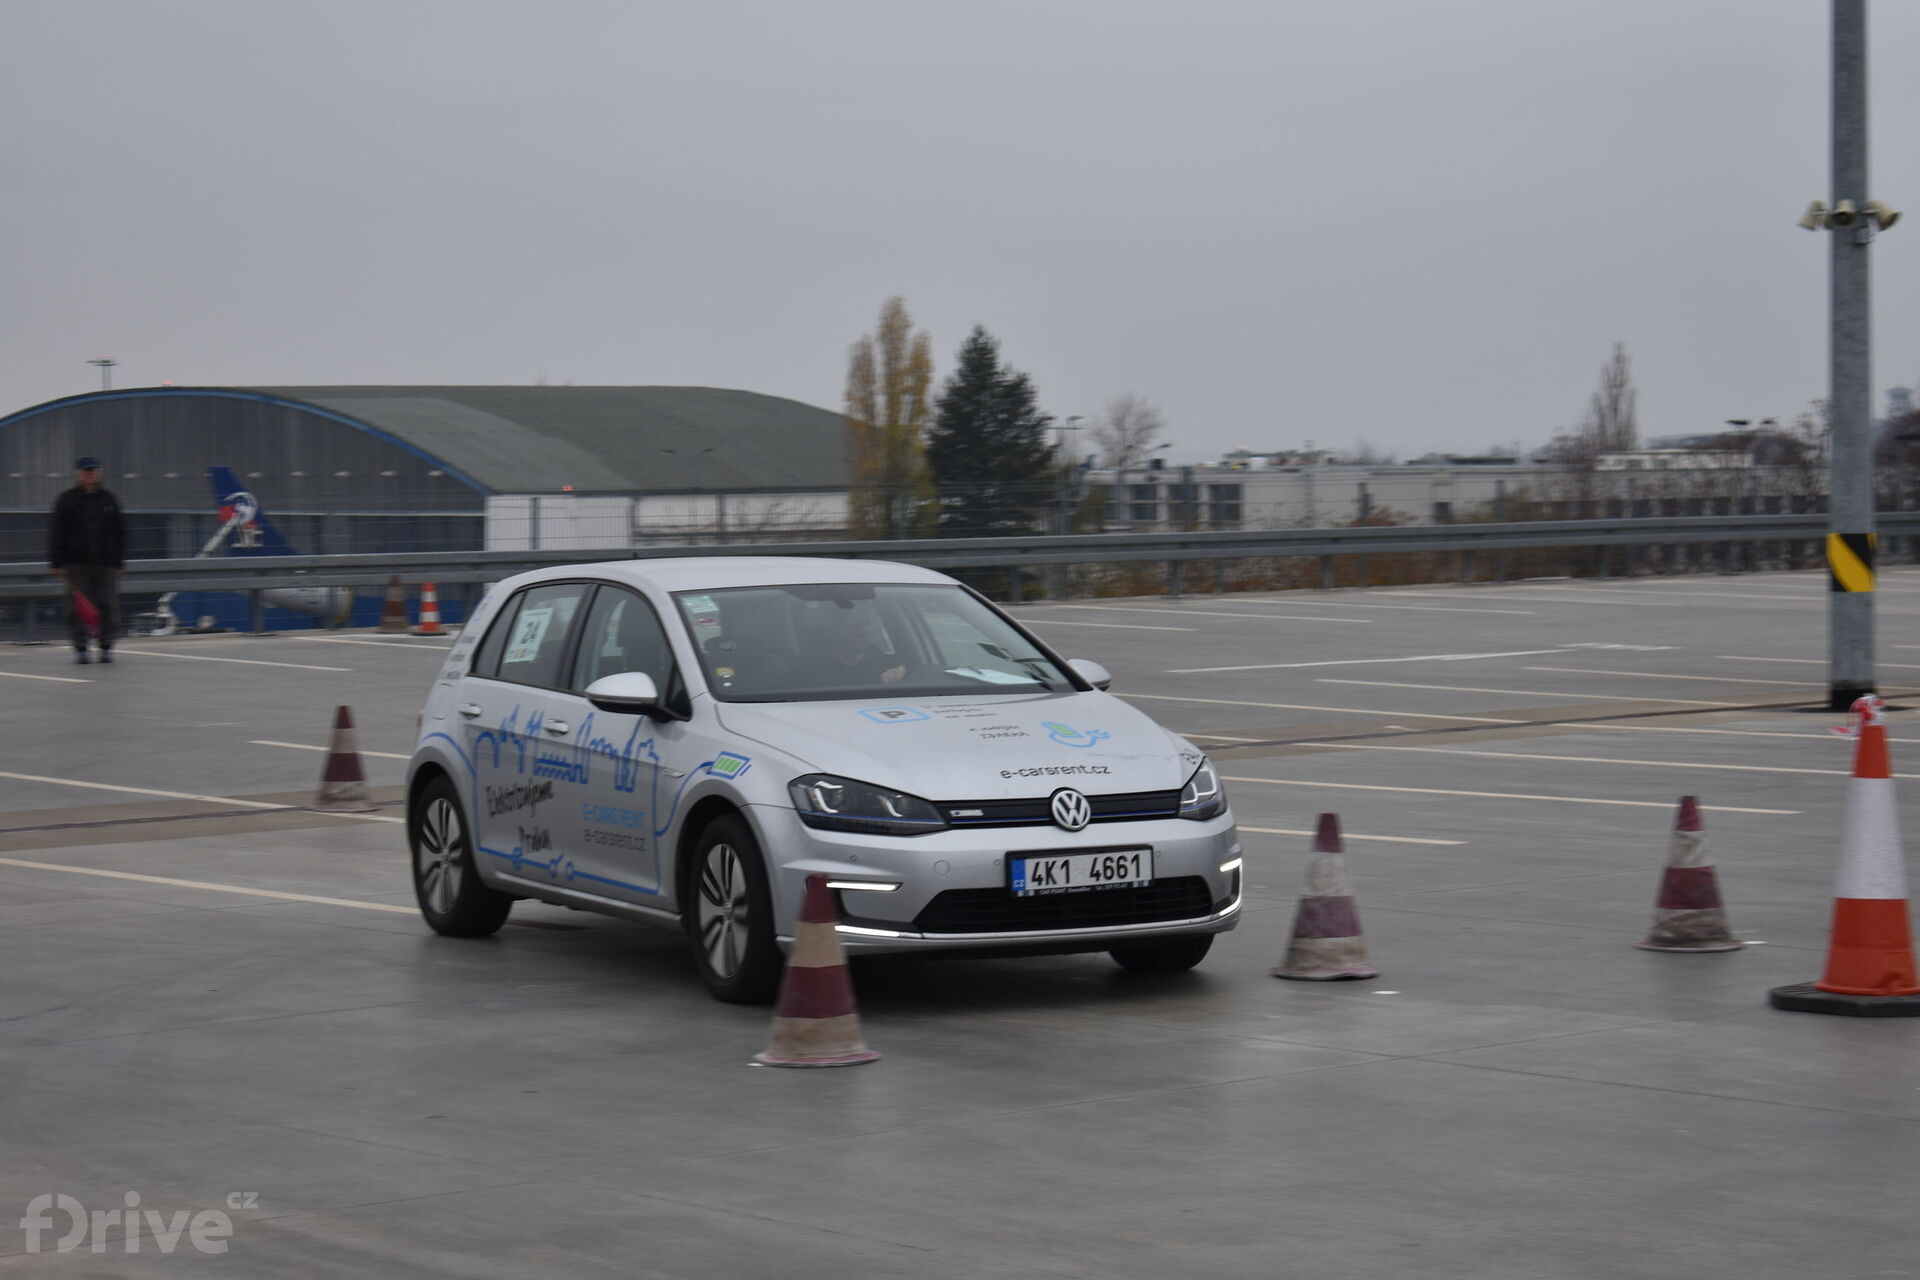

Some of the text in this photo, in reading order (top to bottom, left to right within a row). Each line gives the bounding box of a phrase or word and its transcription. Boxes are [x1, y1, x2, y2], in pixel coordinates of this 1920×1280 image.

[880, 710, 907, 719] P
[1000, 764, 1112, 779] e-carsrent.cz
[1031, 854, 1140, 886] 4K1 4661
[1013, 879, 1025, 888] CZ
